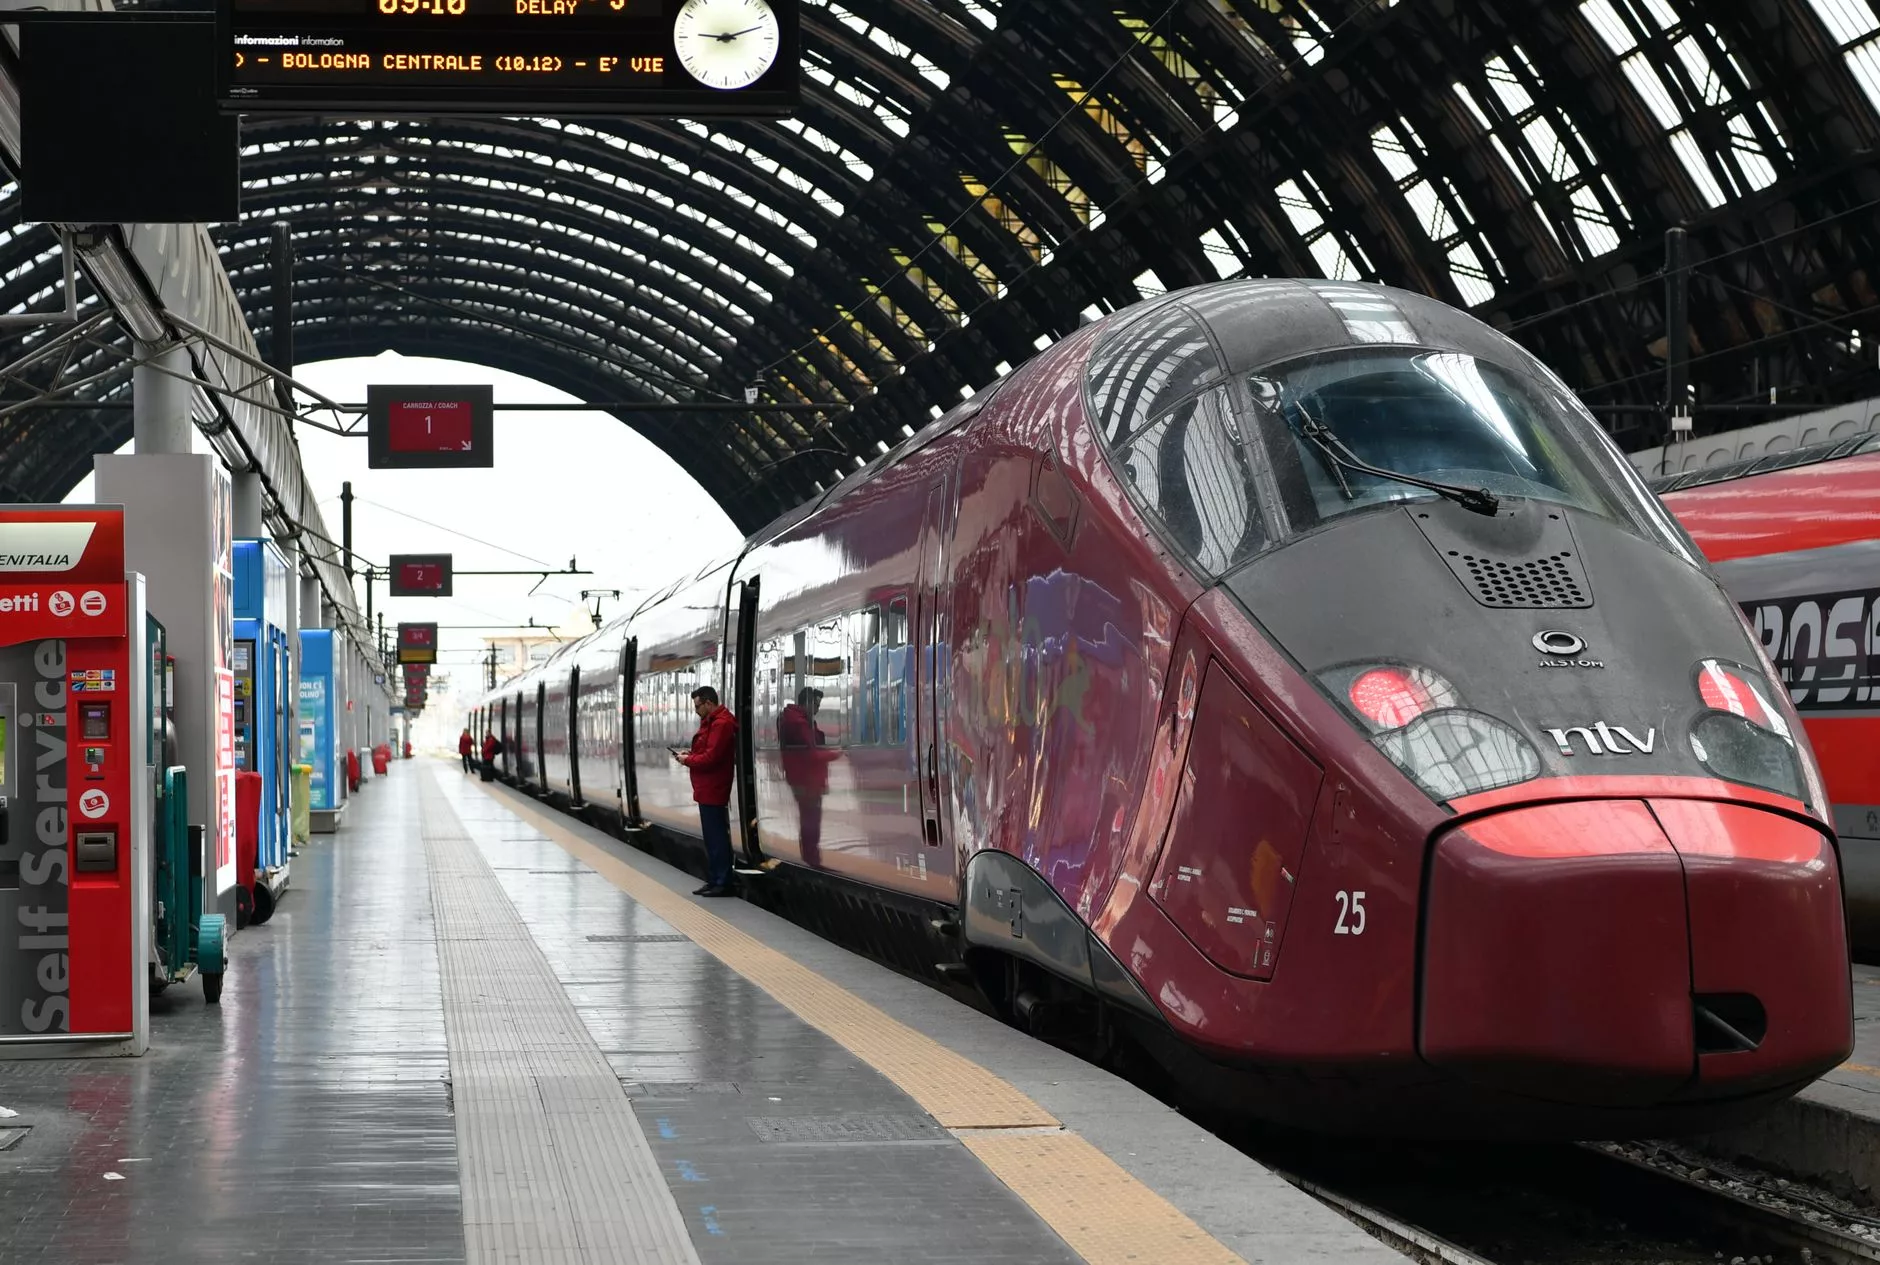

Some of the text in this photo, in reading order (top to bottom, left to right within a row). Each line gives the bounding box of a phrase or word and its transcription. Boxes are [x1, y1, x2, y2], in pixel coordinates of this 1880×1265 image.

[516, 0, 577, 14] DELAY
[234, 35, 345, 46] informazioni information
[283, 53, 370, 69] BOLOGNA
[383, 55, 482, 71] CENTRALE
[496, 56, 562, 71] (10.12)
[631, 58, 664, 73] VIE
[424, 415, 432, 434] 1
[416, 570, 424, 581] 2
[0, 592, 39, 612] etti
[1539, 659, 1604, 669] ALSTOM
[1541, 720, 1656, 756] ntv
[18, 639, 69, 1033] Self Service
[1334, 890, 1366, 935] 25
